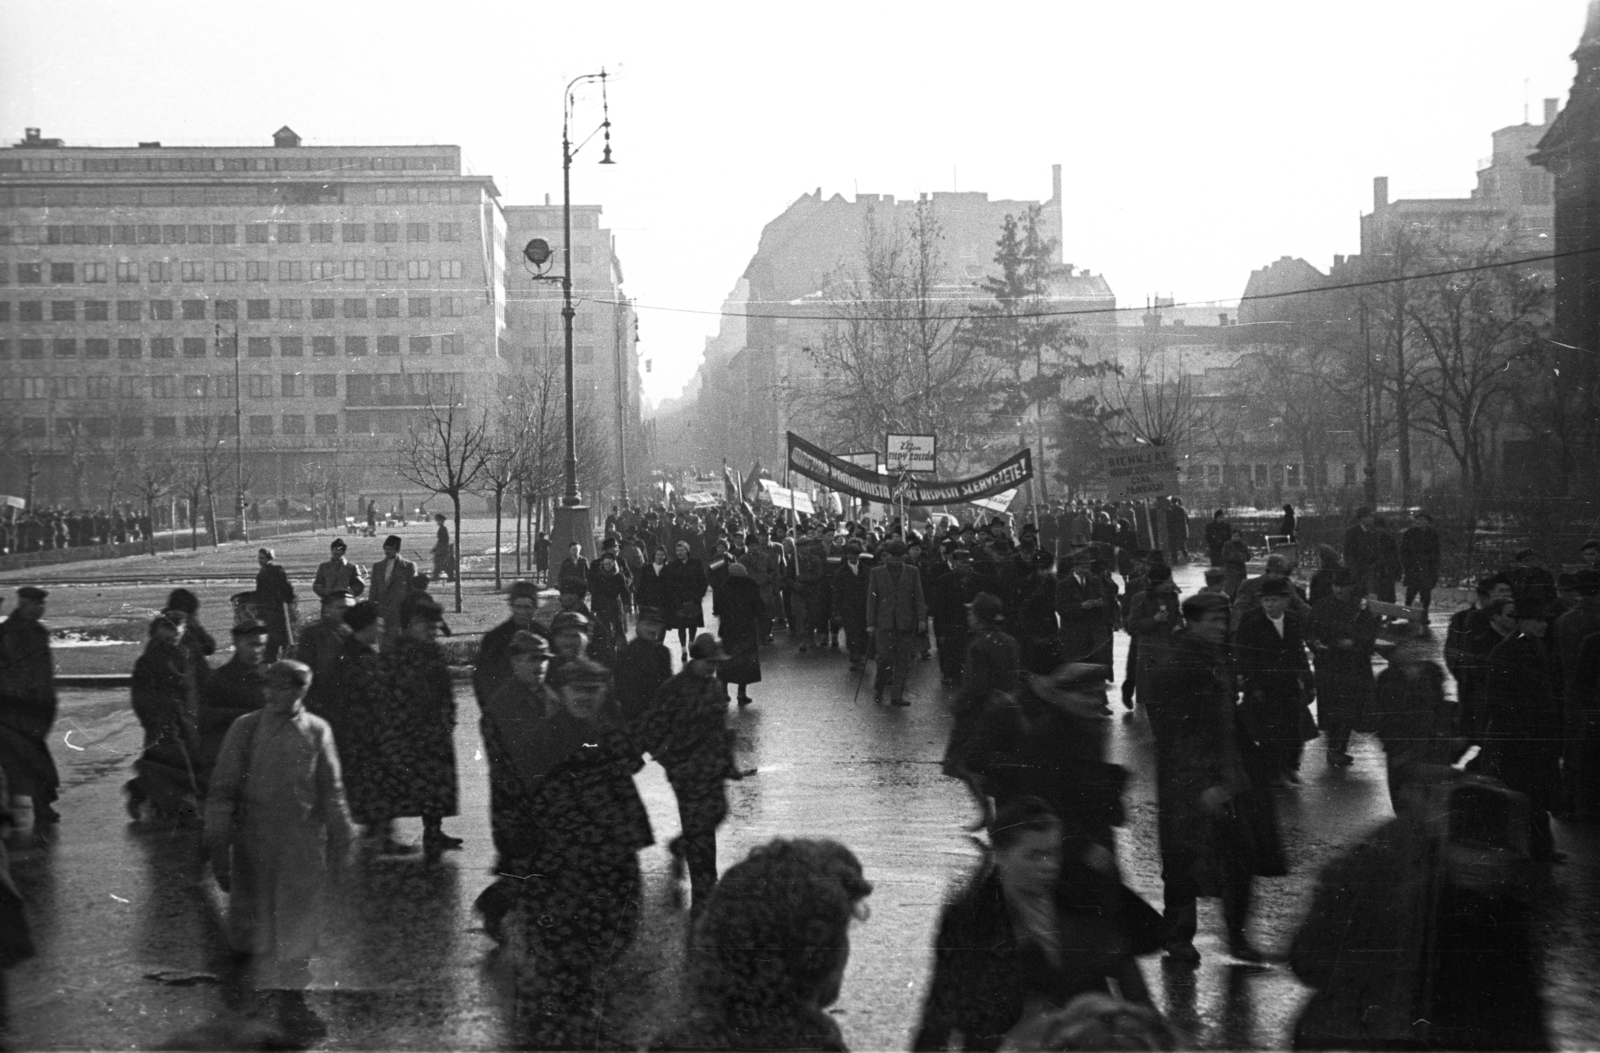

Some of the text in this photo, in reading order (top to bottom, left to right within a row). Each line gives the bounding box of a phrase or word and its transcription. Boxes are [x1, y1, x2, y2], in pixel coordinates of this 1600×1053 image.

[830, 464, 891, 499] KOMMUNISTA
[919, 486, 959, 501] KISPESTI
[962, 458, 1027, 496] SZERVEZETE!
